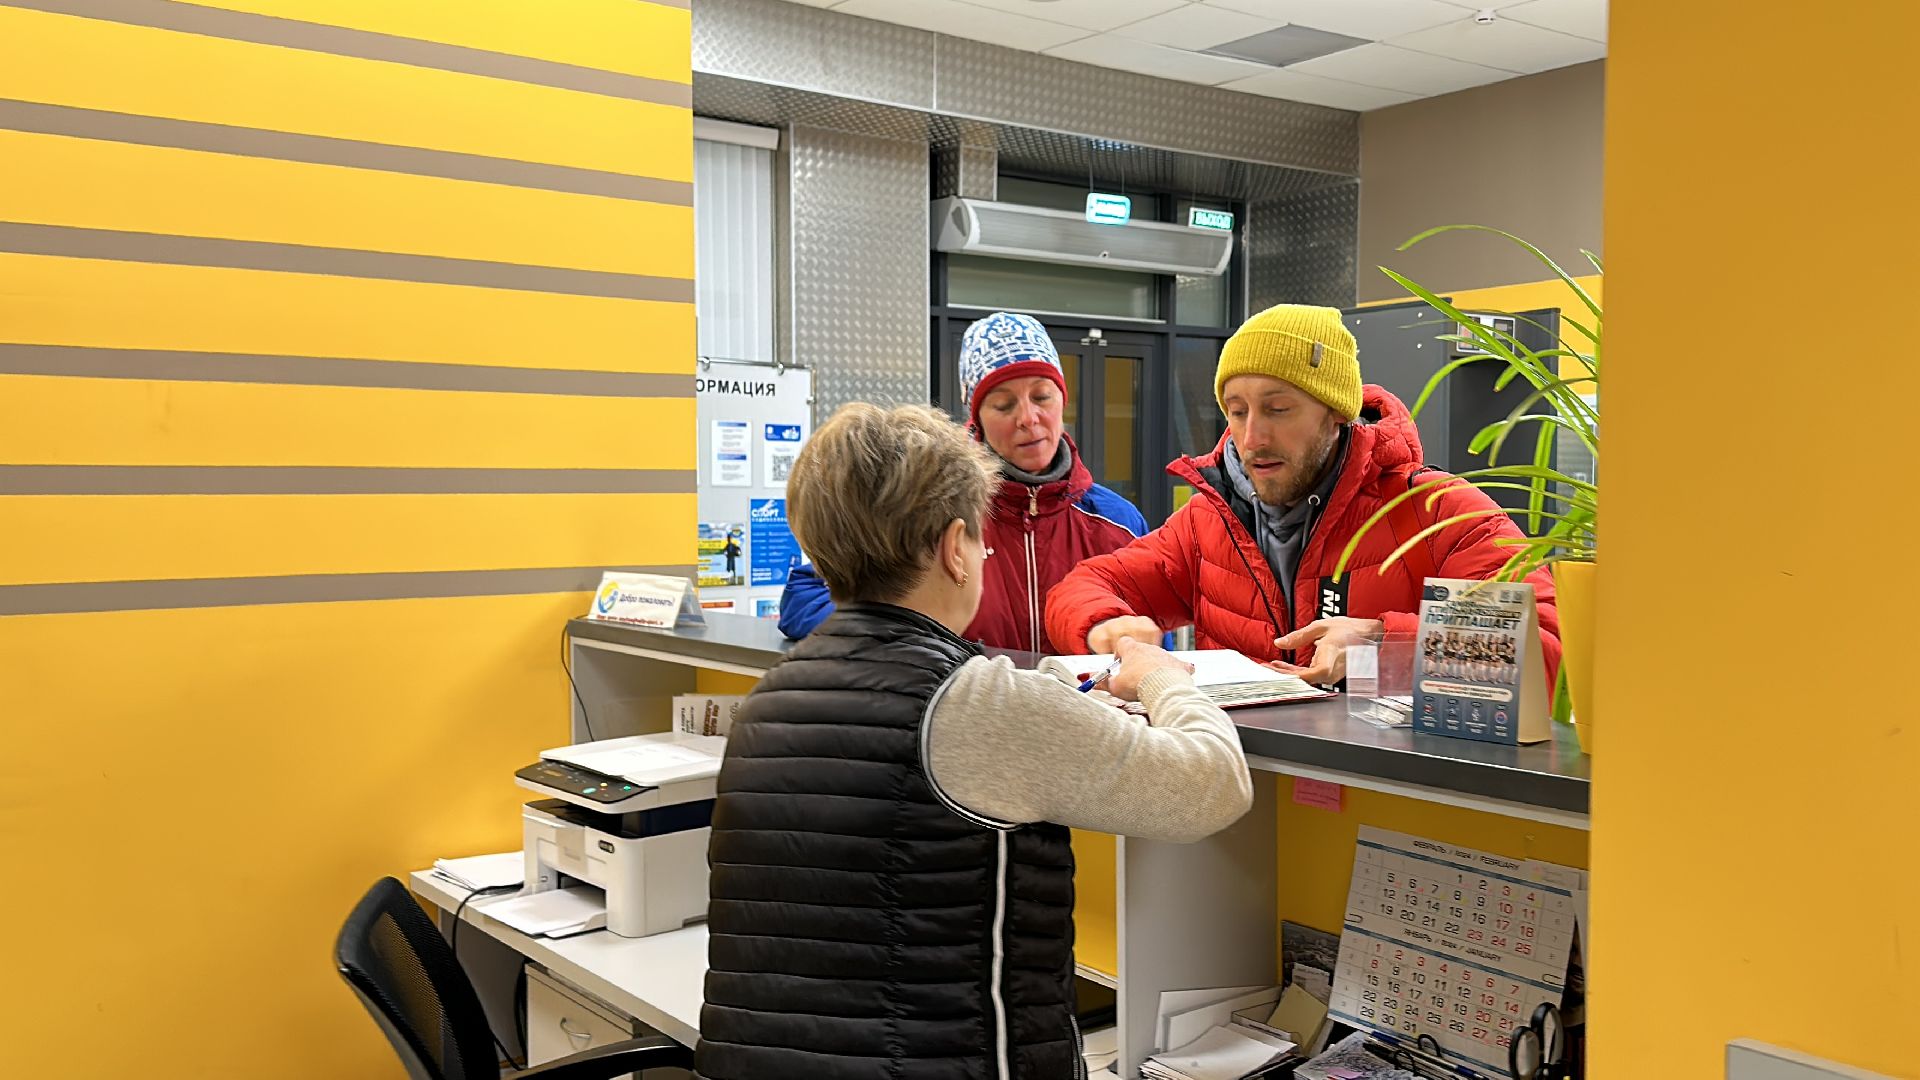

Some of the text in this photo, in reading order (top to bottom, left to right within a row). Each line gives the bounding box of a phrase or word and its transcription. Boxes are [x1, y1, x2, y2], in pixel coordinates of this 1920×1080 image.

[1425, 612, 1521, 631] ПРИГЛАШАЕТ
[1480, 856, 1520, 870] FEBRUARY
[1383, 888, 1396, 900] 12
[1405, 894, 1418, 906] 13
[1425, 900, 1440, 912] 14
[1449, 906, 1463, 918] 15
[1472, 913, 1486, 924] 16
[1496, 918, 1512, 930] 17
[1520, 926, 1534, 938] 18
[1387, 873, 1536, 920] 5 6 7 8 9 10 11
[1478, 880, 1487, 890] 2
[1502, 886, 1511, 896] 3
[1526, 892, 1535, 901] 4
[1380, 904, 1531, 955] 19 20 21 22 23 24 25
[1394, 950, 1404, 960] 2
[1417, 956, 1425, 966] 3
[1439, 964, 1447, 973] 4
[1462, 970, 1471, 980] 5
[1486, 978, 1495, 988] 6
[1510, 984, 1519, 994] 7
[1465, 947, 1502, 962] JANUARY
[1367, 974, 1514, 1030] 15 16 17 18 19 20 21
[1371, 960, 1518, 1014] 8 9 10 11 12 13 14
[1360, 1006, 1416, 1033] 29 30 31
[1362, 990, 1377, 1002] 22
[1384, 997, 1398, 1009] 23
[1405, 1004, 1419, 1017] 24
[1426, 1012, 1442, 1024] 25
[1449, 1020, 1465, 1032] 26
[1472, 1027, 1488, 1039] 27
